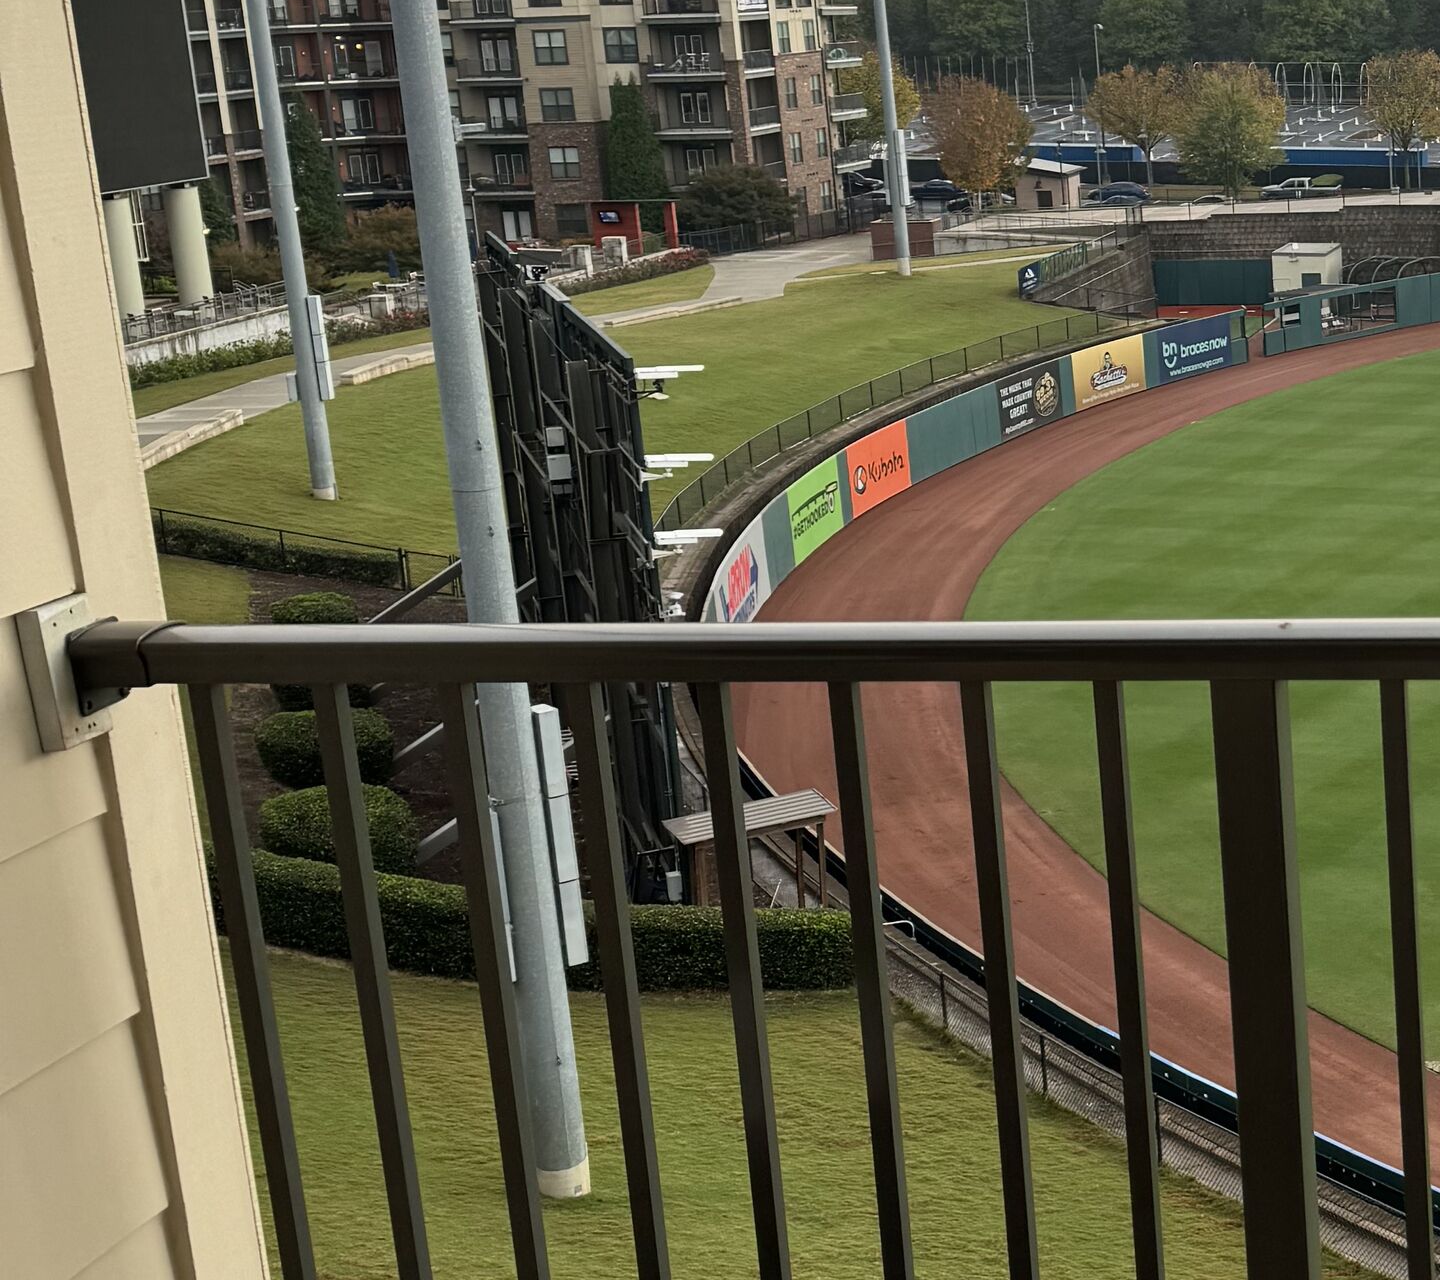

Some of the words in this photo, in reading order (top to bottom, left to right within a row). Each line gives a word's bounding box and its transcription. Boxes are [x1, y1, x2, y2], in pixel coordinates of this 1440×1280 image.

[1000, 387, 1009, 397] THE
[1010, 403, 1028, 419] GREAT!
[868, 451, 904, 482] Kubota
